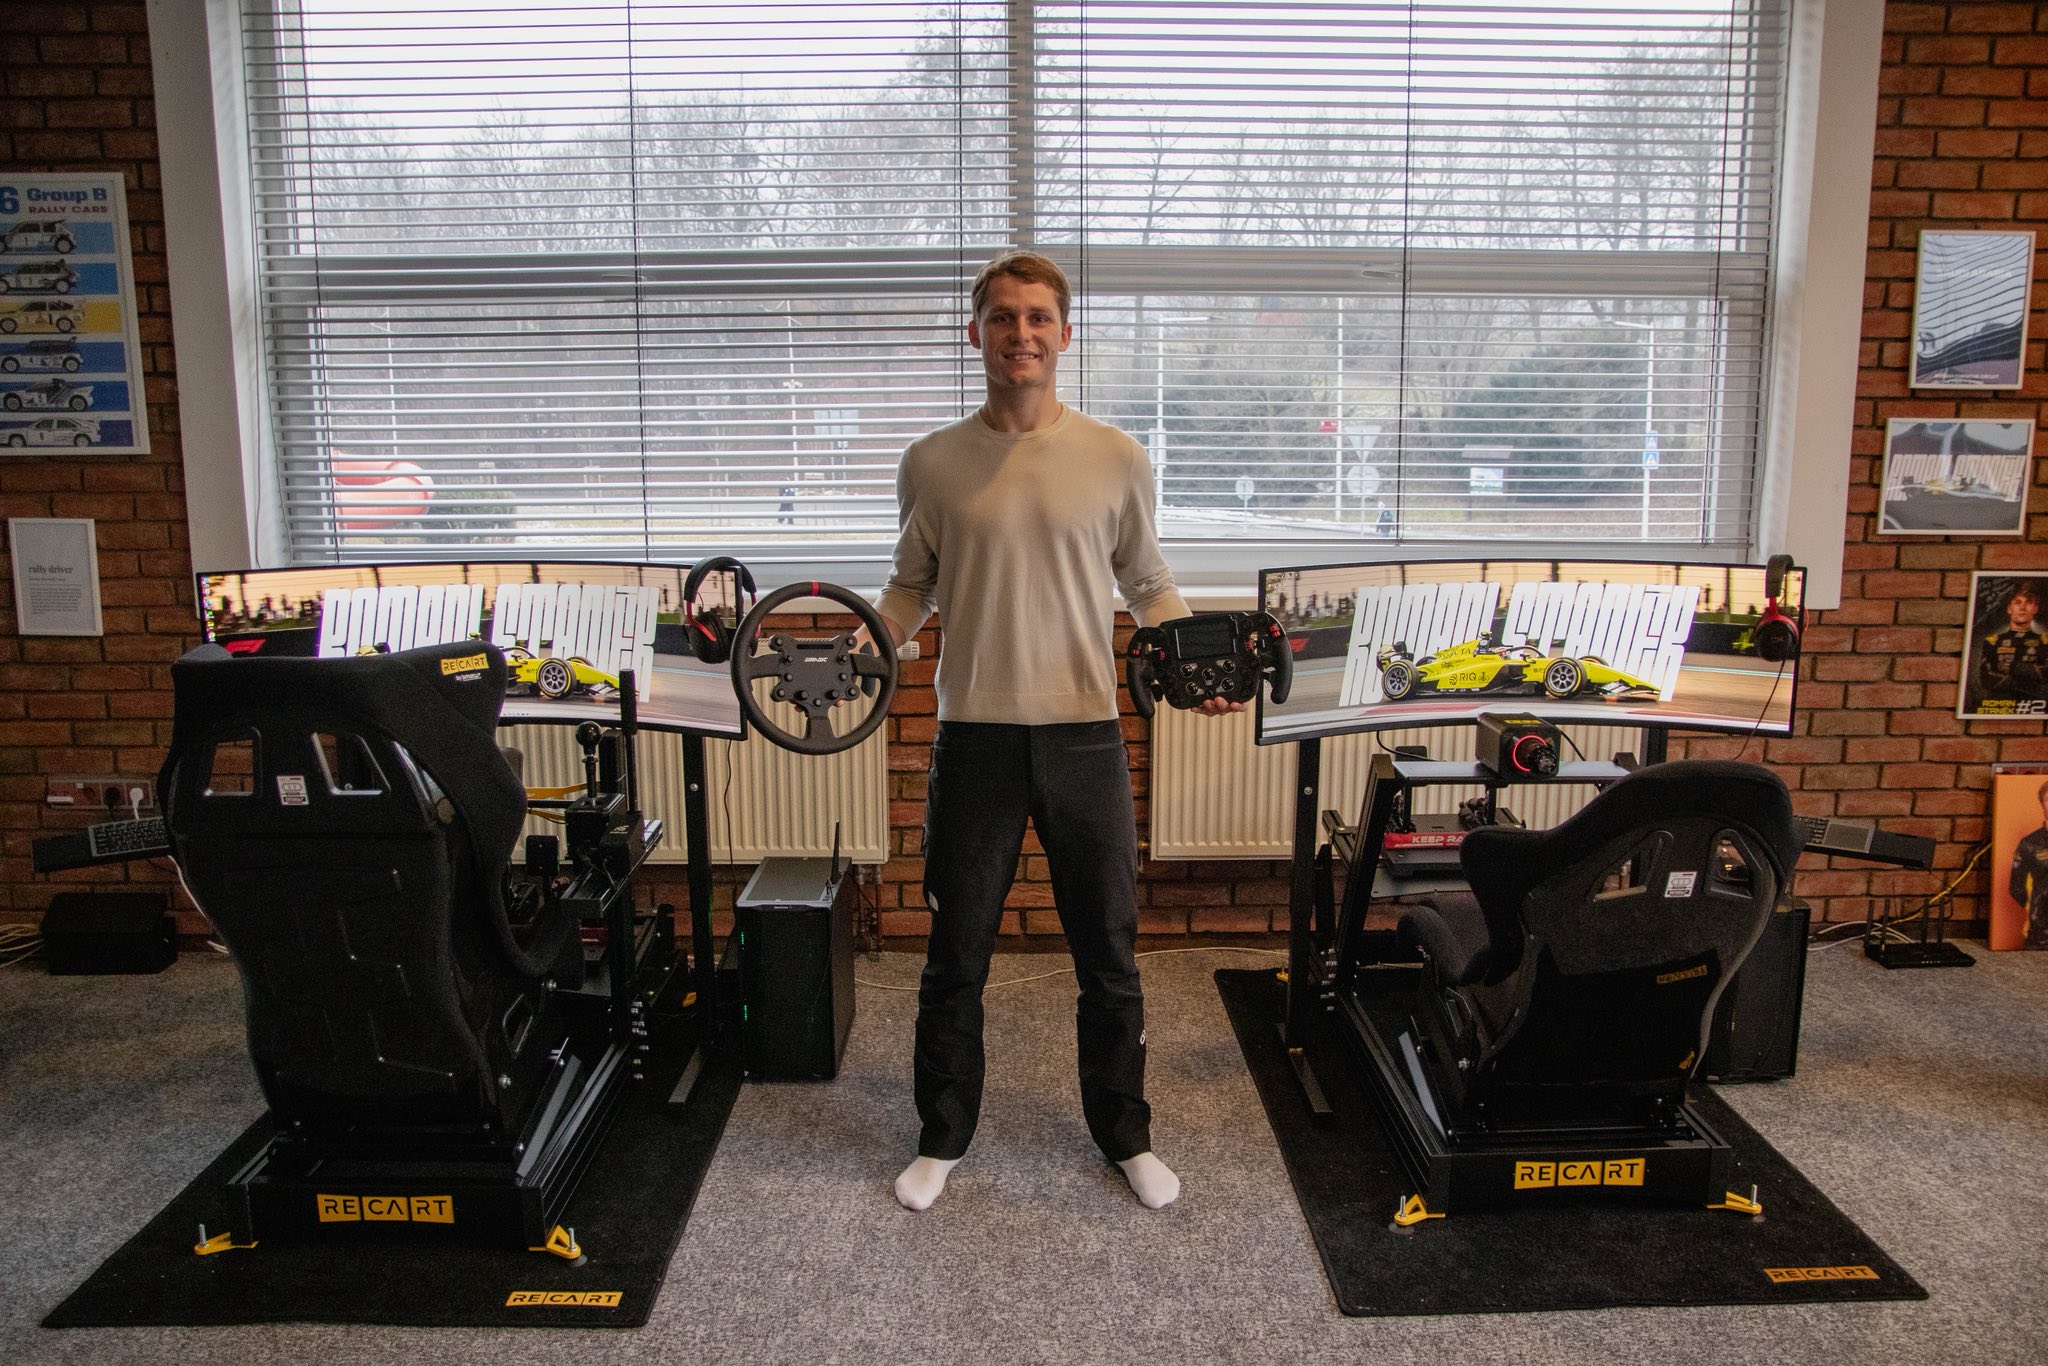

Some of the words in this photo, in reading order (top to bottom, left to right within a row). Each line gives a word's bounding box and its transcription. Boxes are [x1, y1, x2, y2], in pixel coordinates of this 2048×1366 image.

[27, 188, 88, 204] Group
[93, 188, 107, 200] B
[29, 565, 47, 574] rally
[48, 565, 73, 573] driver
[442, 657, 486, 671] RECART
[1460, 673, 1476, 681] RIQ
[2016, 700, 2046, 714] #2
[1520, 1162, 1640, 1181] RECART
[323, 1198, 448, 1216] RECART
[1770, 1267, 1870, 1279] RECART
[512, 1294, 617, 1303] RECART
